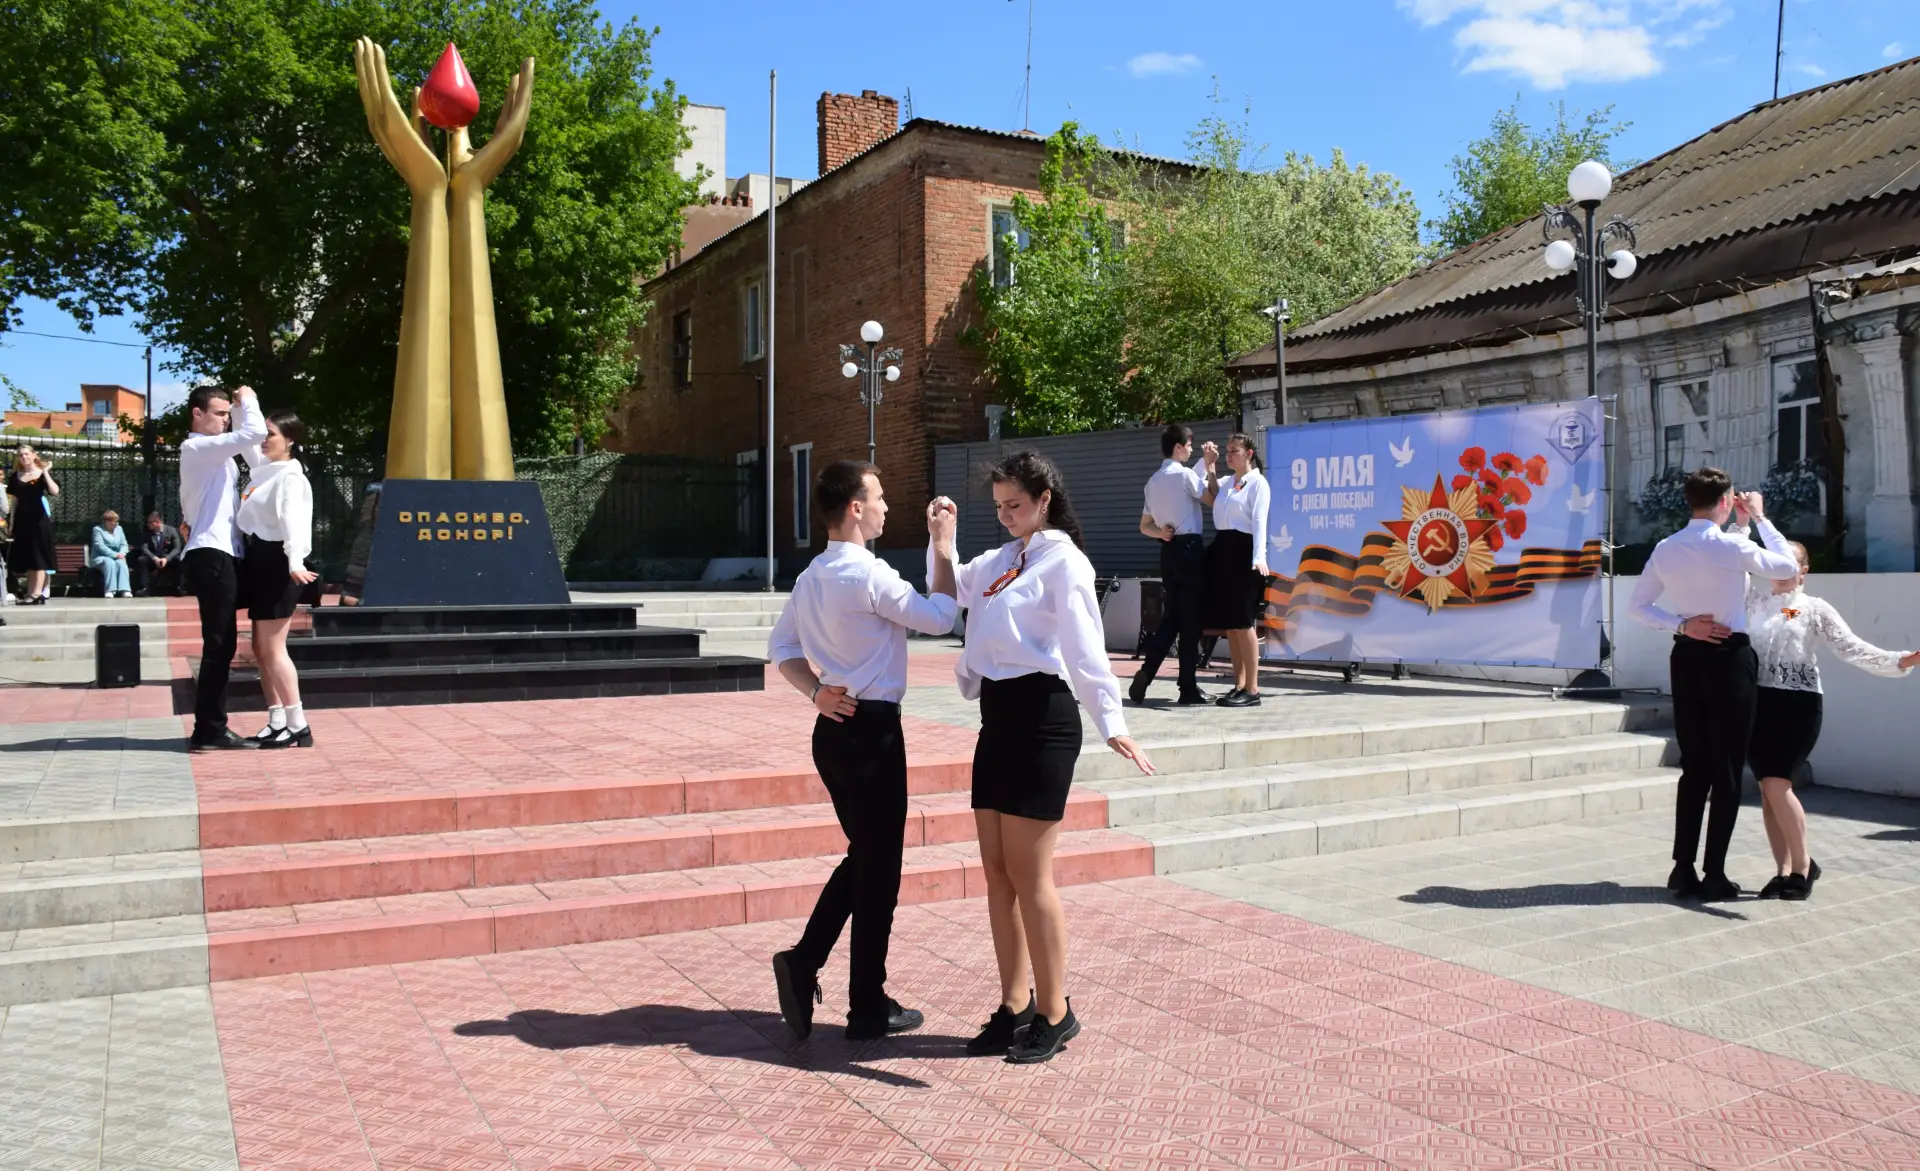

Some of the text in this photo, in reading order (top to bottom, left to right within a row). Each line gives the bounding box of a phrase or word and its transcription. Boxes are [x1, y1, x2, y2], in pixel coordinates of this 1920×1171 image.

[1291, 454, 1374, 490] 9 МАЯ
[1292, 494, 1299, 511] С
[1330, 491, 1374, 511] ПОБЕДЫ!
[417, 525, 513, 541] ДОНОР!
[1409, 510, 1462, 570] ОТЕЧЕСТВЕННАЯ
